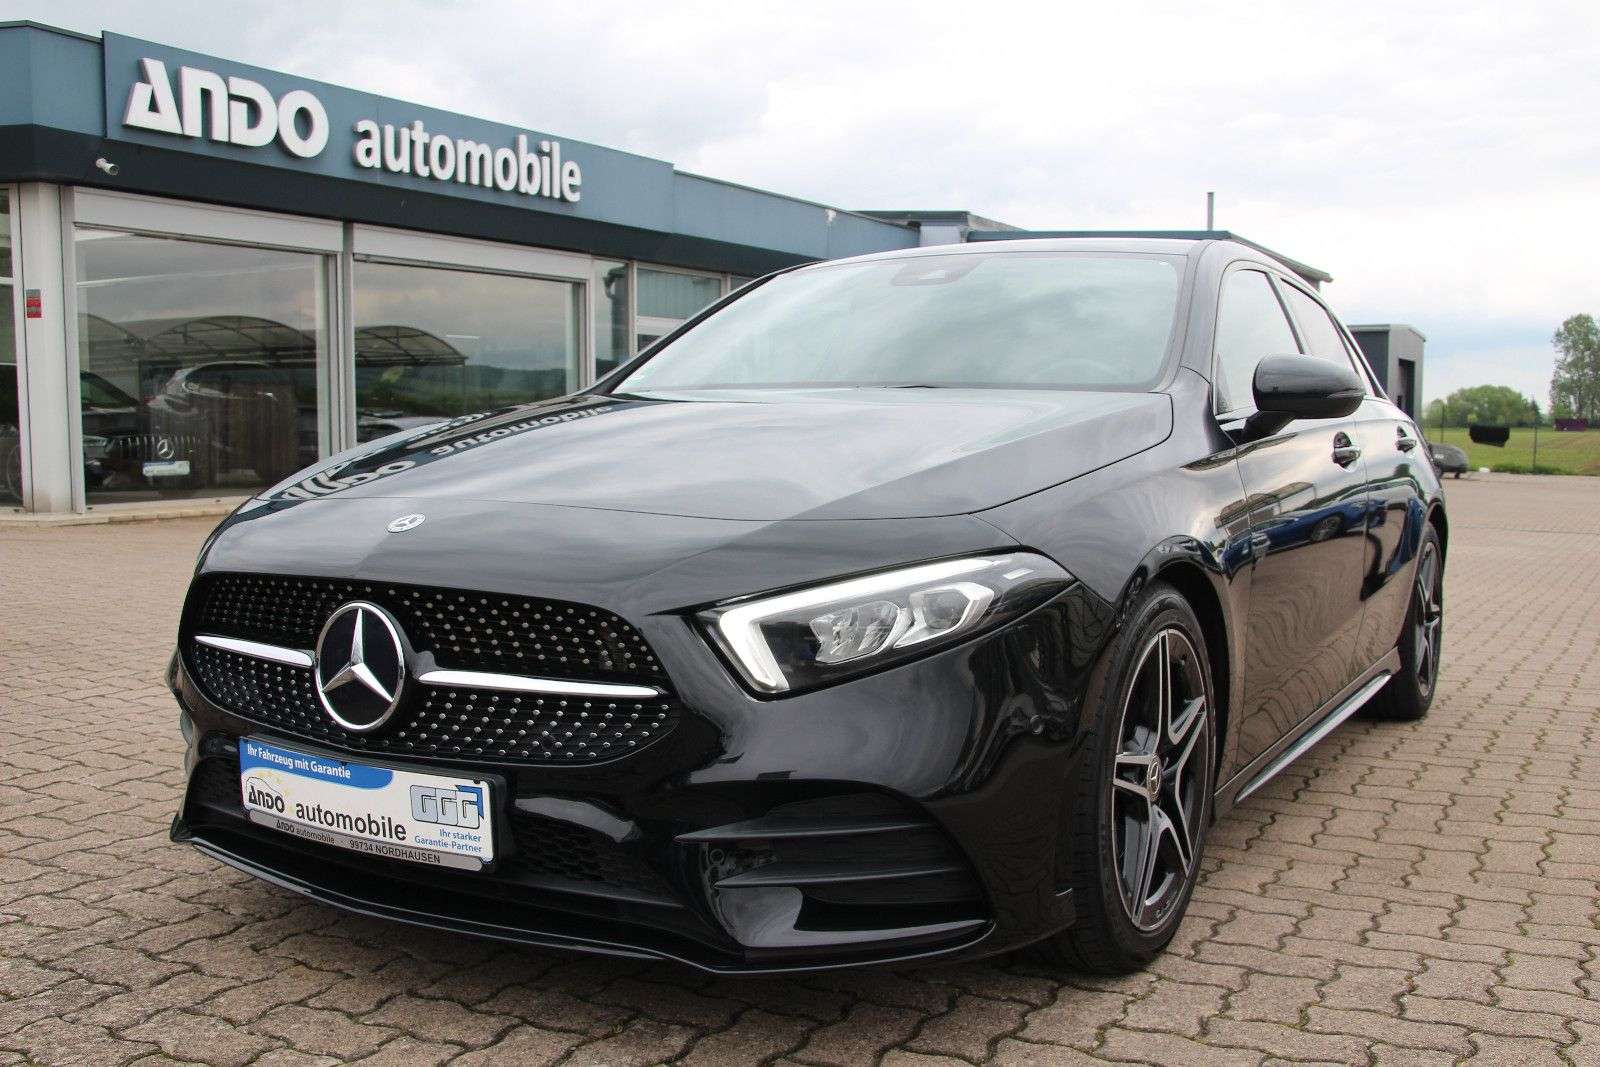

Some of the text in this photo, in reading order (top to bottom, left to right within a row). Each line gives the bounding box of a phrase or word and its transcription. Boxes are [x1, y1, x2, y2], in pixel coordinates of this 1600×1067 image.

[122, 57, 583, 202] ANDO automobile
[247, 743, 352, 779] Ihr Fahrzeug mit Garantie
[248, 784, 407, 841] ANDO automobile
[276, 819, 441, 864] ANDO automobile 99734 NORDHAUSEN
[439, 828, 482, 843] Ihr starker
